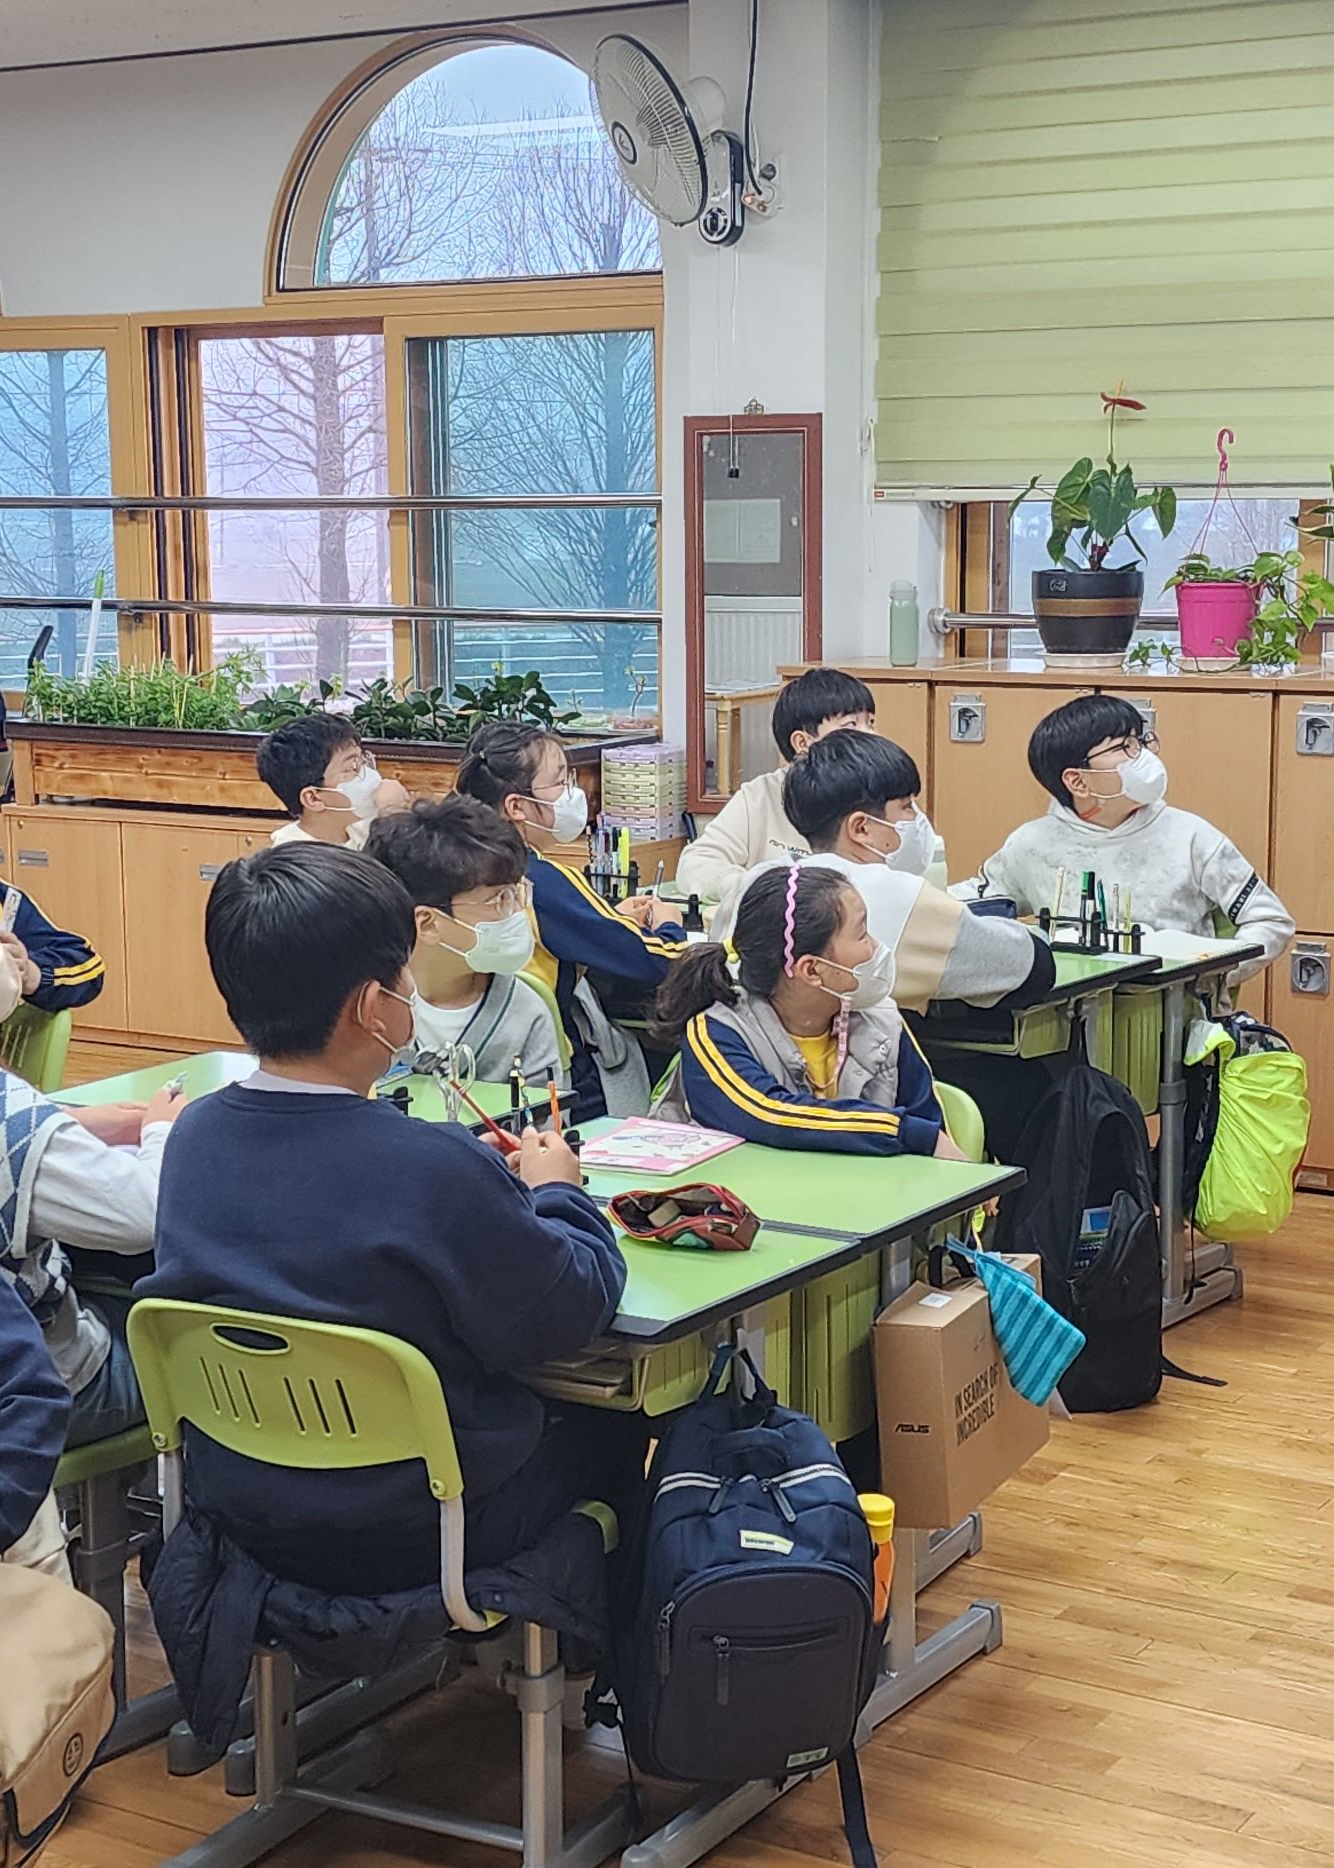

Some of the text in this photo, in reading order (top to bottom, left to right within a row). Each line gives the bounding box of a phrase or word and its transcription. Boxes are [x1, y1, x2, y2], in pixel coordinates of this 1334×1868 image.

[955, 1392, 963, 1419] IN
[963, 1369, 988, 1411] SEARCH
[895, 1424, 930, 1433] ASUS
